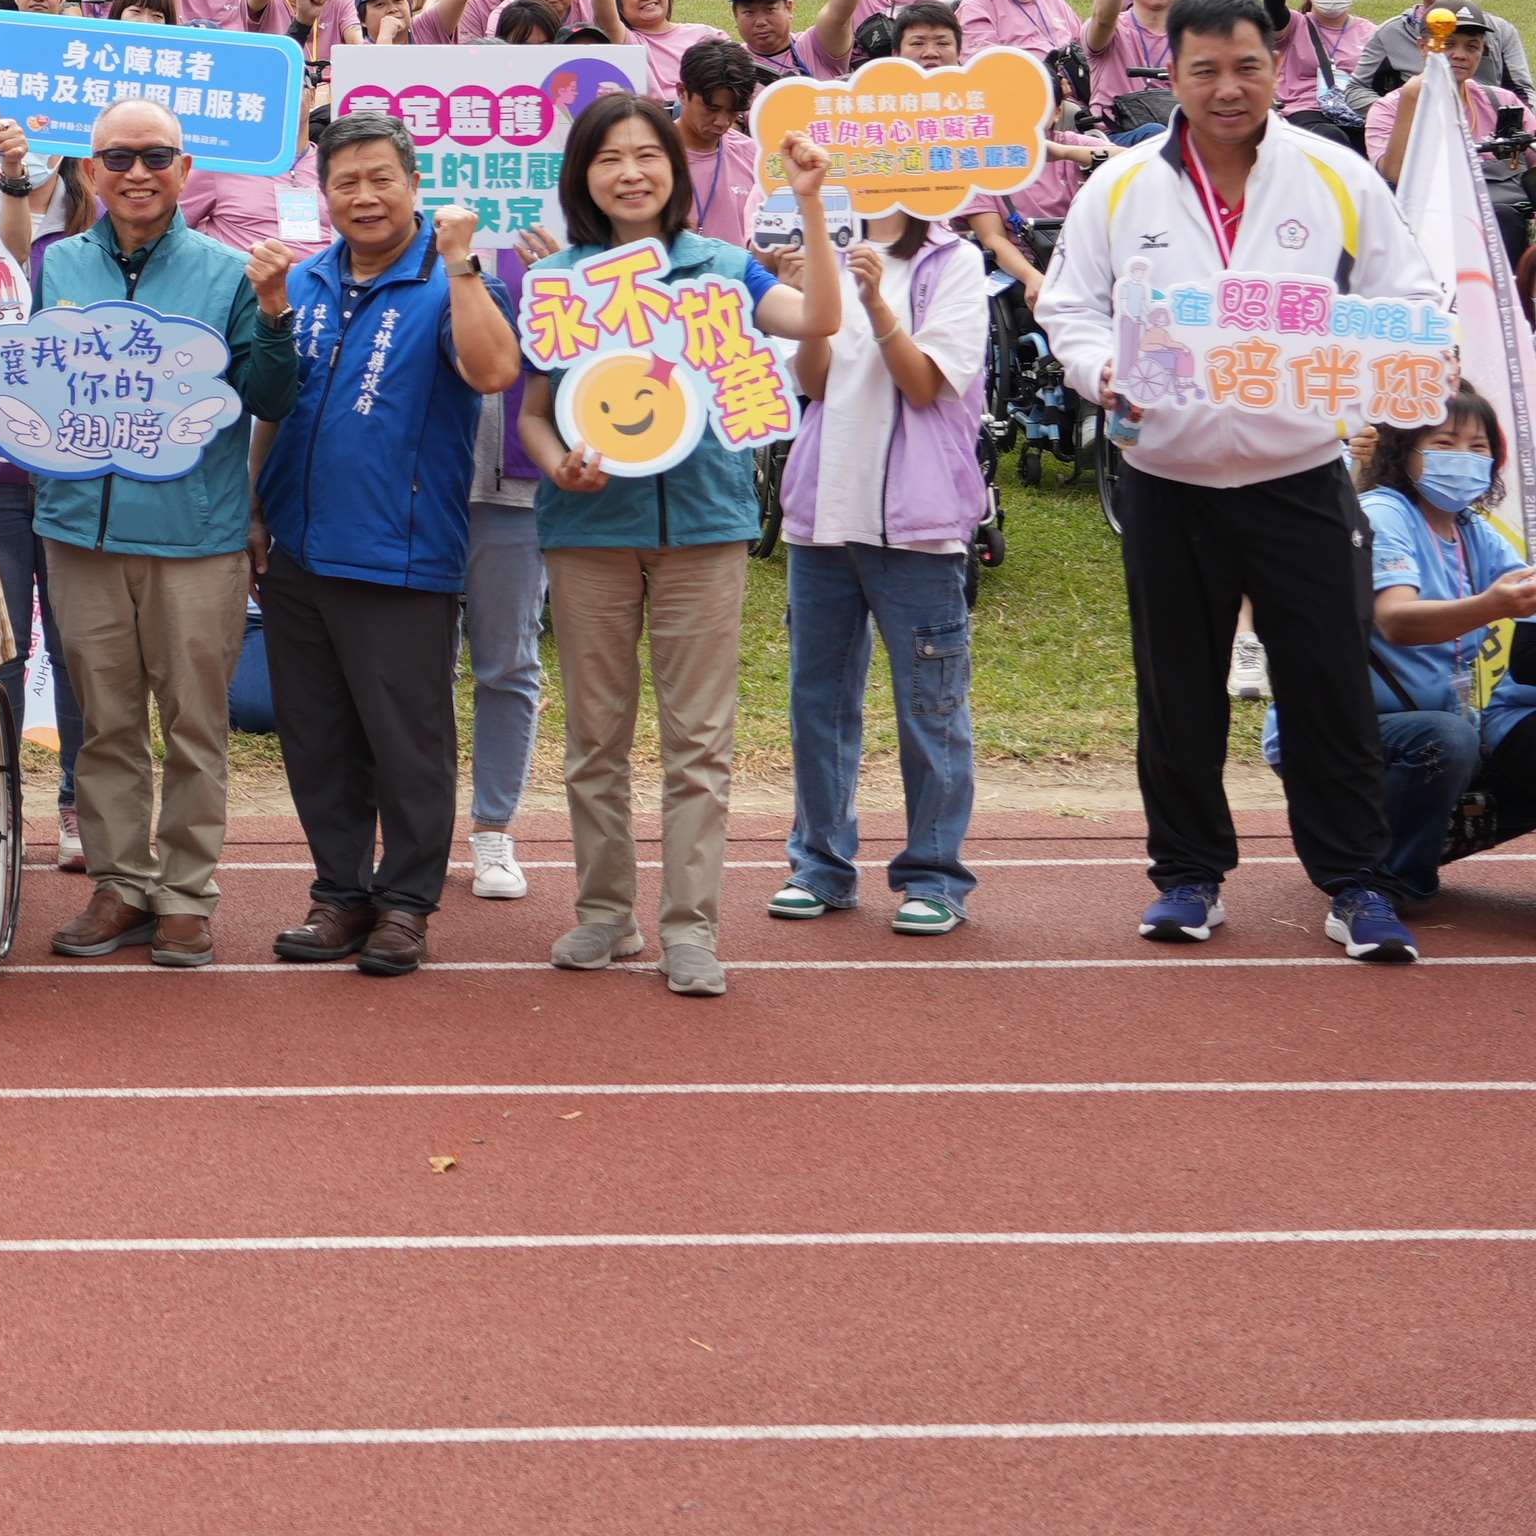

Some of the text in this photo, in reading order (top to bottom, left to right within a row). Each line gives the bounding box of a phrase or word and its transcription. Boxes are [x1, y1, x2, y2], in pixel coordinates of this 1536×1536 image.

[62, 39, 215, 82] 身心障礙者
[808, 113, 995, 148] 提供身心障礙者
[1171, 278, 1452, 345] 在照顧的路上
[352, 307, 401, 416] 雲林縣政府
[528, 245, 791, 445] 永不放棄
[66, 368, 154, 406] 你的
[1205, 336, 1444, 422] 陪伴您
[56, 408, 166, 460] 翅膀
